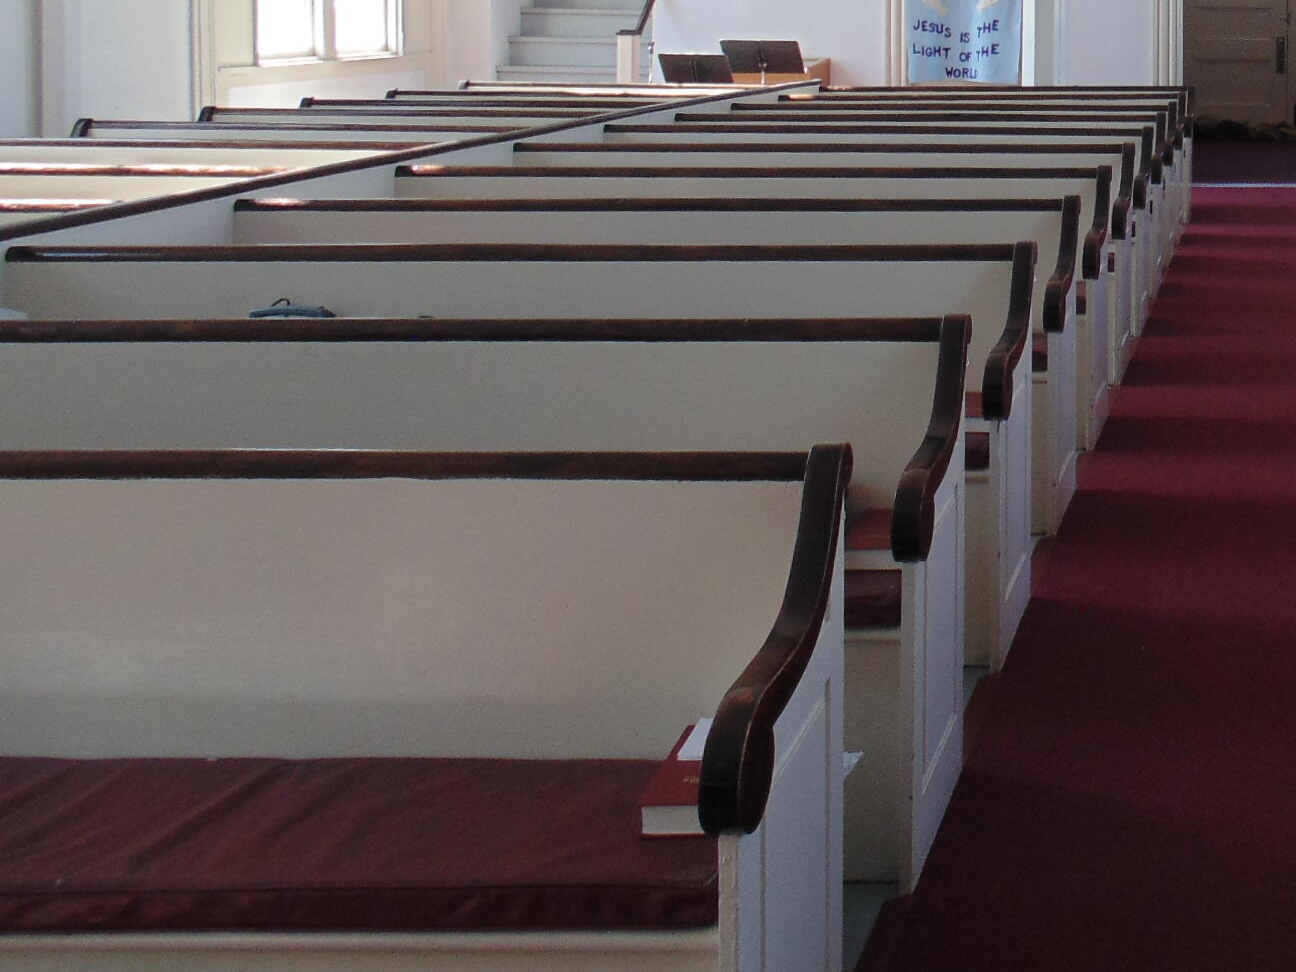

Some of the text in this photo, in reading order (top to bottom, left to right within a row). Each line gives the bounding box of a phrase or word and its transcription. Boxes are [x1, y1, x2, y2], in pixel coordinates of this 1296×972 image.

[912, 19, 1000, 44] JESUS IS THE
[912, 43, 1000, 63] LIGHT OF THE
[945, 67, 979, 80] WORLD
